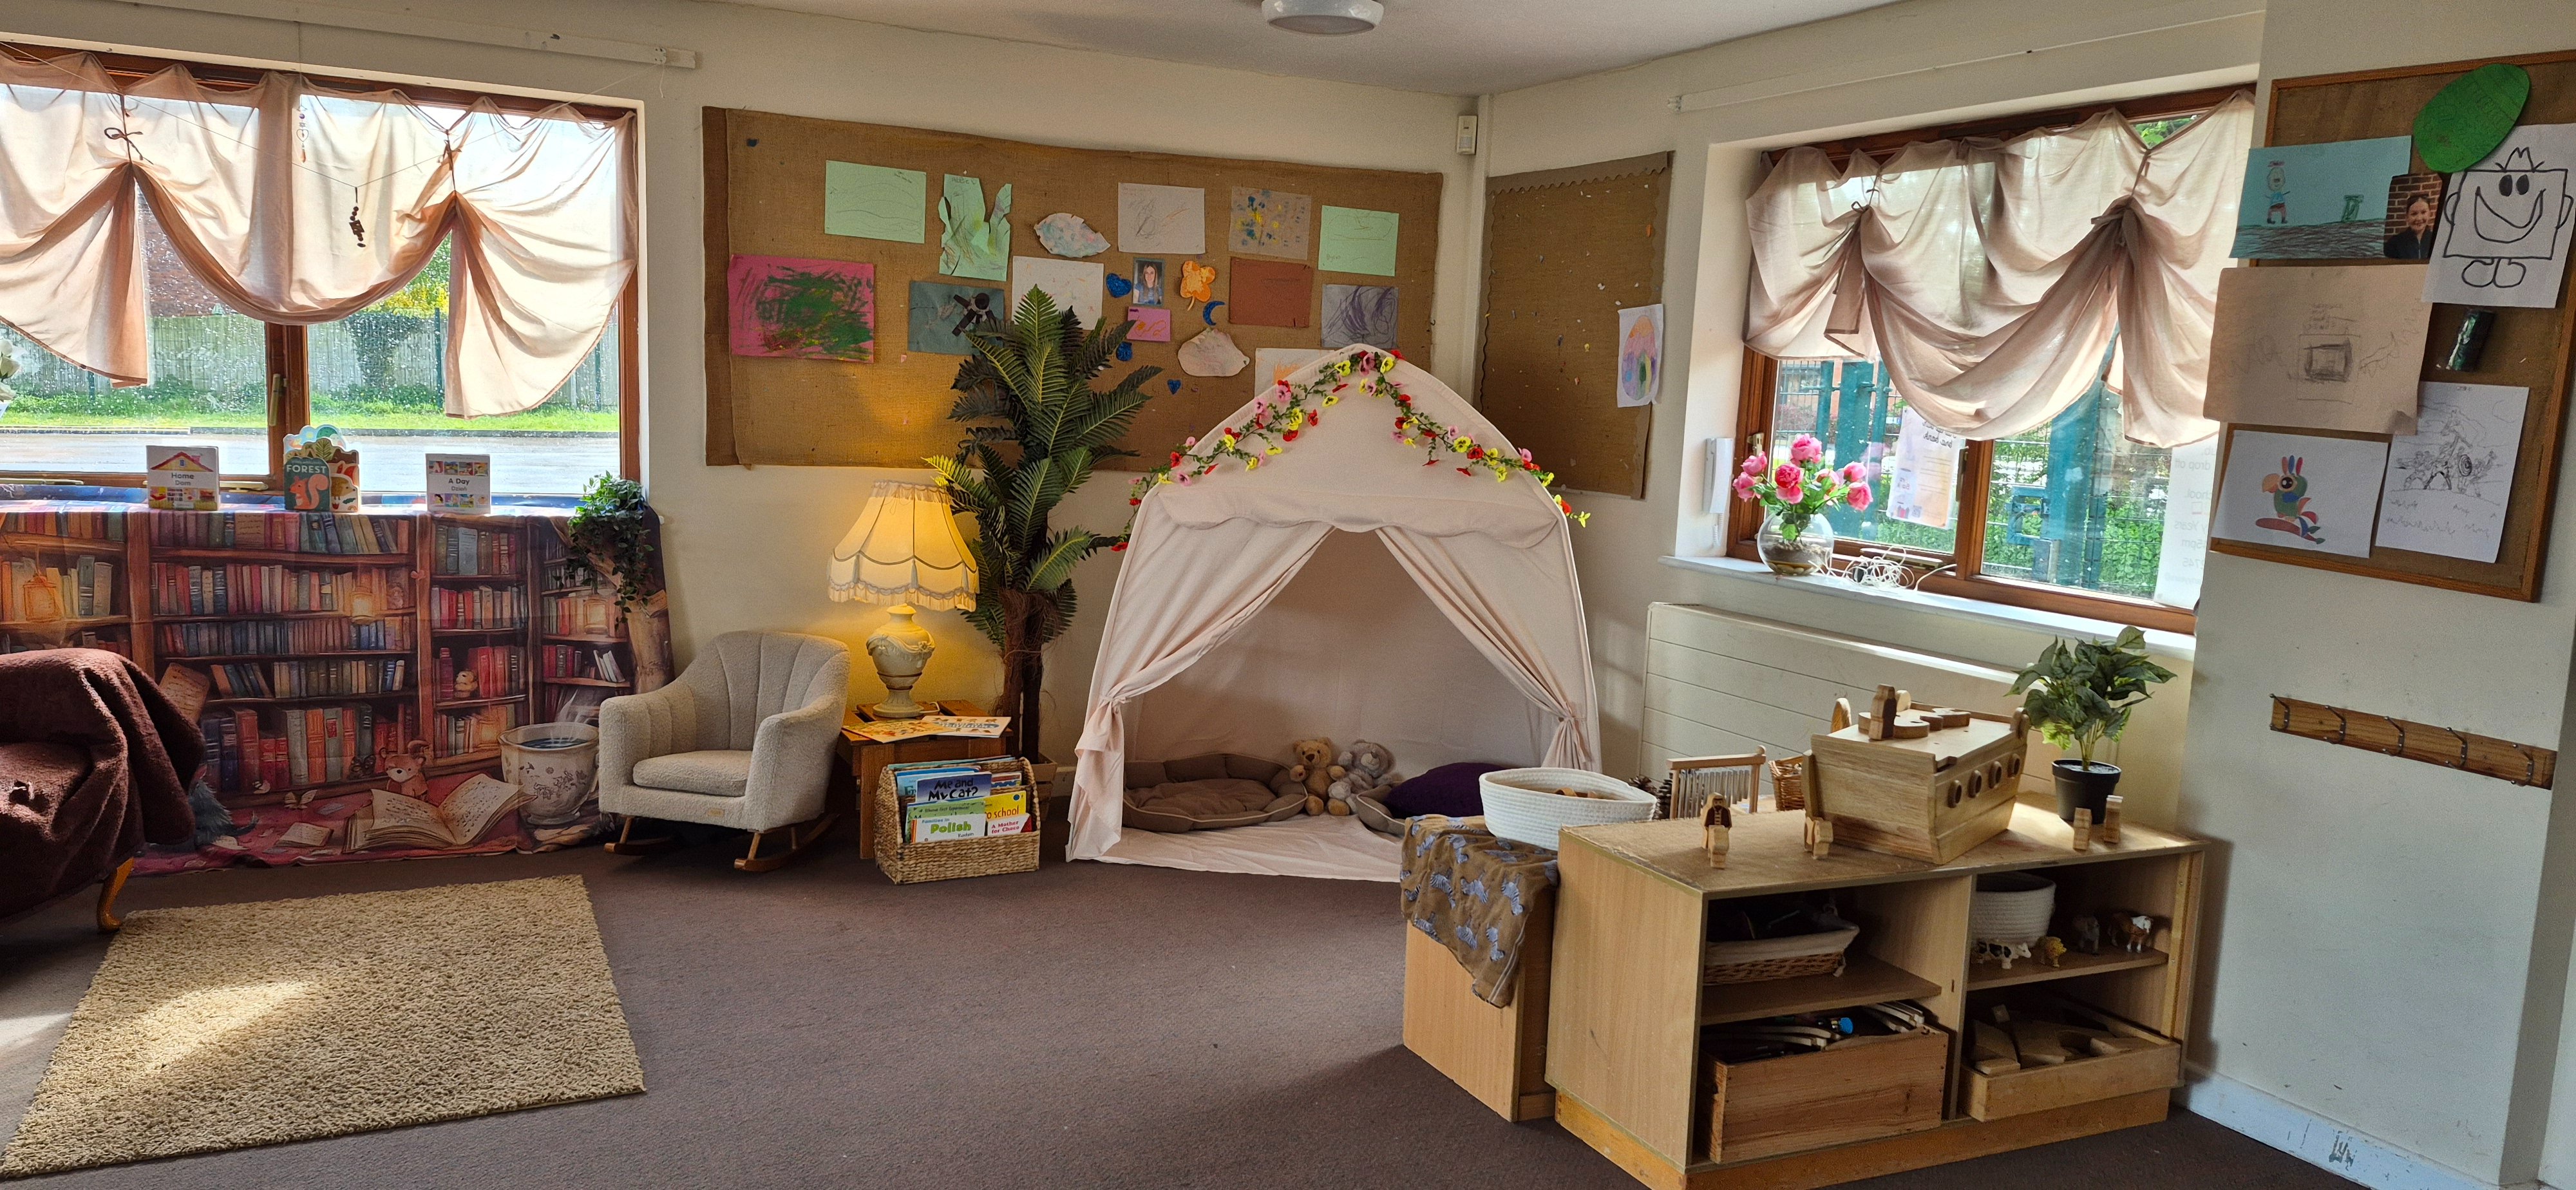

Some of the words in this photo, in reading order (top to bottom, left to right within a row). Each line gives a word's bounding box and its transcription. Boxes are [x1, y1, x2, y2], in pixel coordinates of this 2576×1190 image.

[286, 464, 327, 474] FOREST
[934, 780, 953, 790] Me
[954, 777, 974, 788] and
[949, 786, 979, 799] Cat?
[994, 804, 1019, 818] school
[930, 820, 972, 834] Polish
